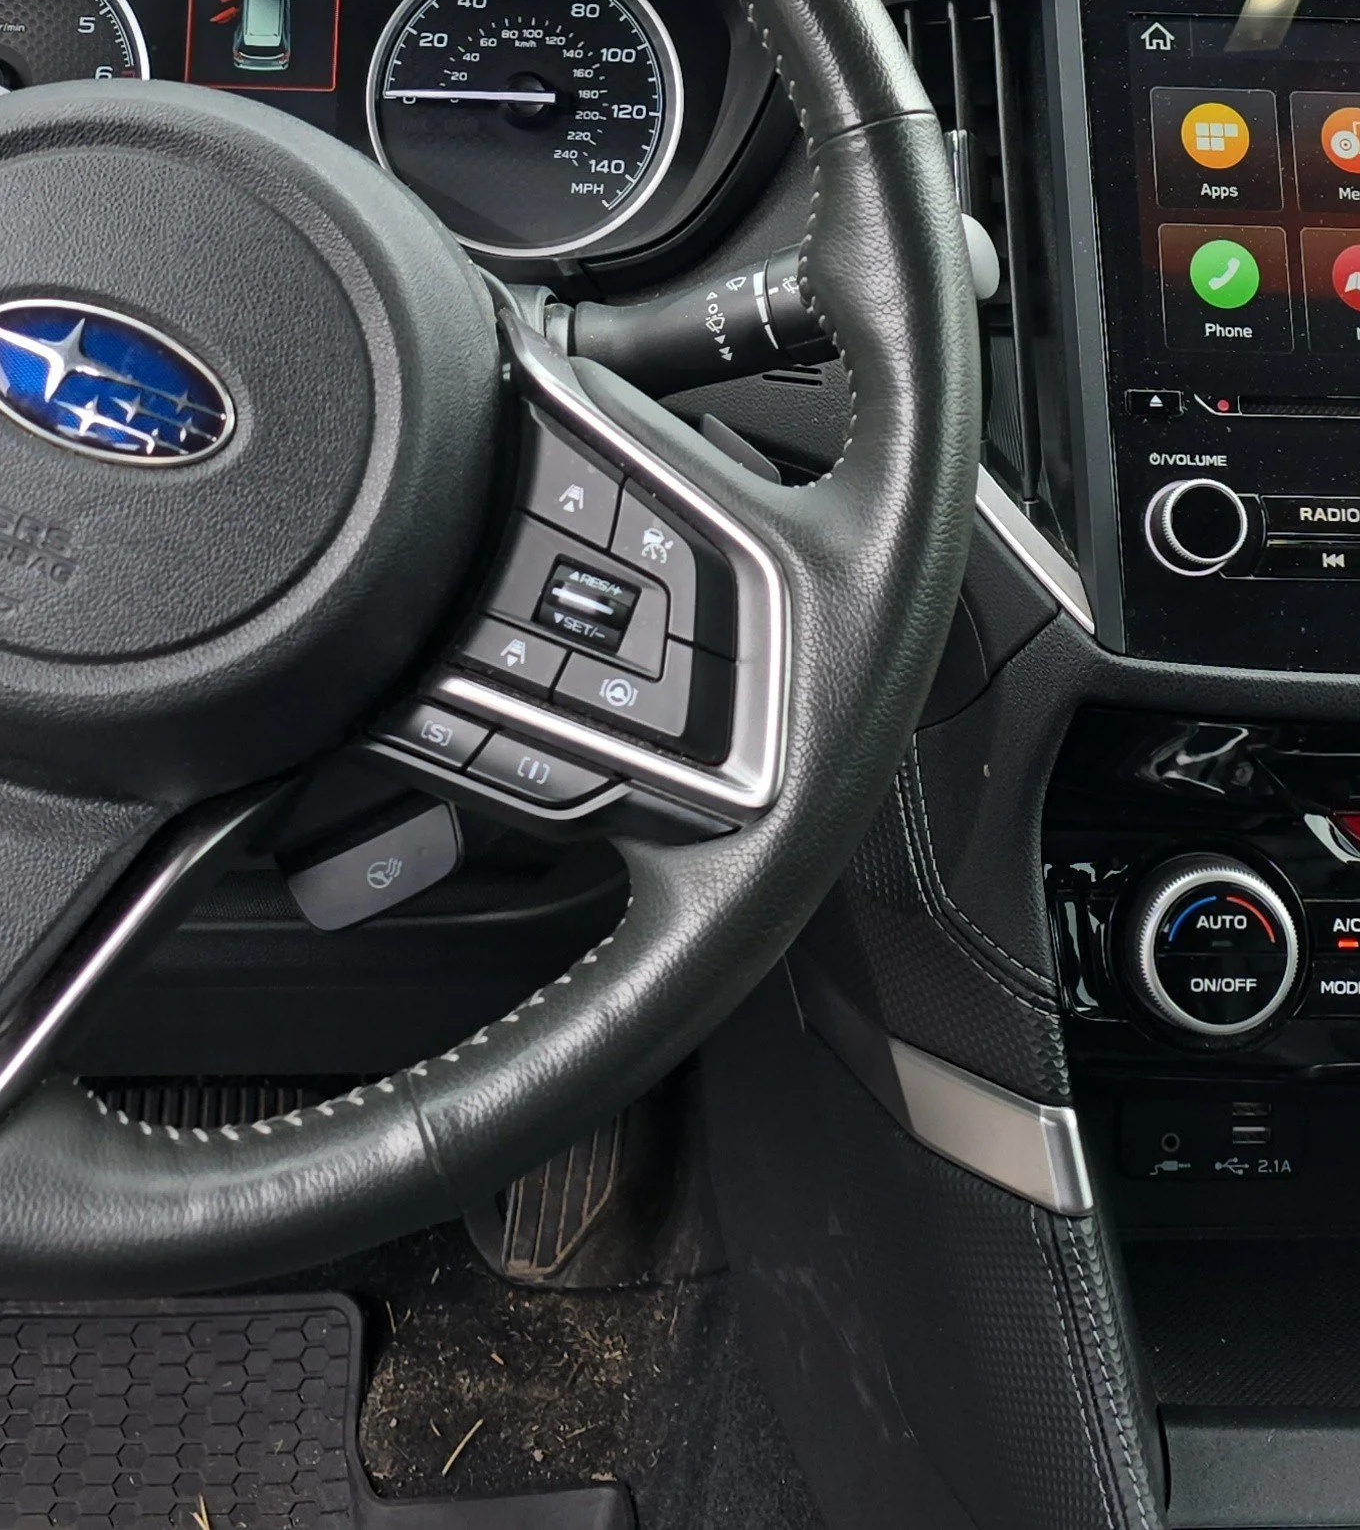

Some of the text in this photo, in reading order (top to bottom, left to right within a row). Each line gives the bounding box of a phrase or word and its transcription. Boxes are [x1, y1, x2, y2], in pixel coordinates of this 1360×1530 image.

[570, 4, 600, 18] 80
[78, 17, 96, 34] 5
[501, 29, 519, 39] 80
[522, 29, 544, 39] 100
[419, 33, 448, 48] 20
[480, 37, 497, 47] 60
[514, 39, 537, 48] km/h
[545, 36, 566, 46] 120
[462, 53, 480, 62] 40
[562, 49, 584, 59] 140
[600, 48, 636, 63] 100
[450, 71, 468, 82] 20
[573, 68, 594, 78] 160
[578, 90, 599, 99] 180
[575, 111, 599, 120] 200
[611, 105, 647, 119] 120
[567, 131, 591, 141] 220
[554, 149, 578, 159] 240
[589, 160, 625, 174] 140
[570, 183, 604, 195] MPH
[1199, 181, 1239, 202] Apps
[1204, 321, 1254, 339] Phone
[1299, 505, 1360, 524] RADIO
[1196, 914, 1248, 930] AUTO
[1190, 977, 1257, 993] ON/OFF
[1257, 1159, 1292, 1173] 2.1A
